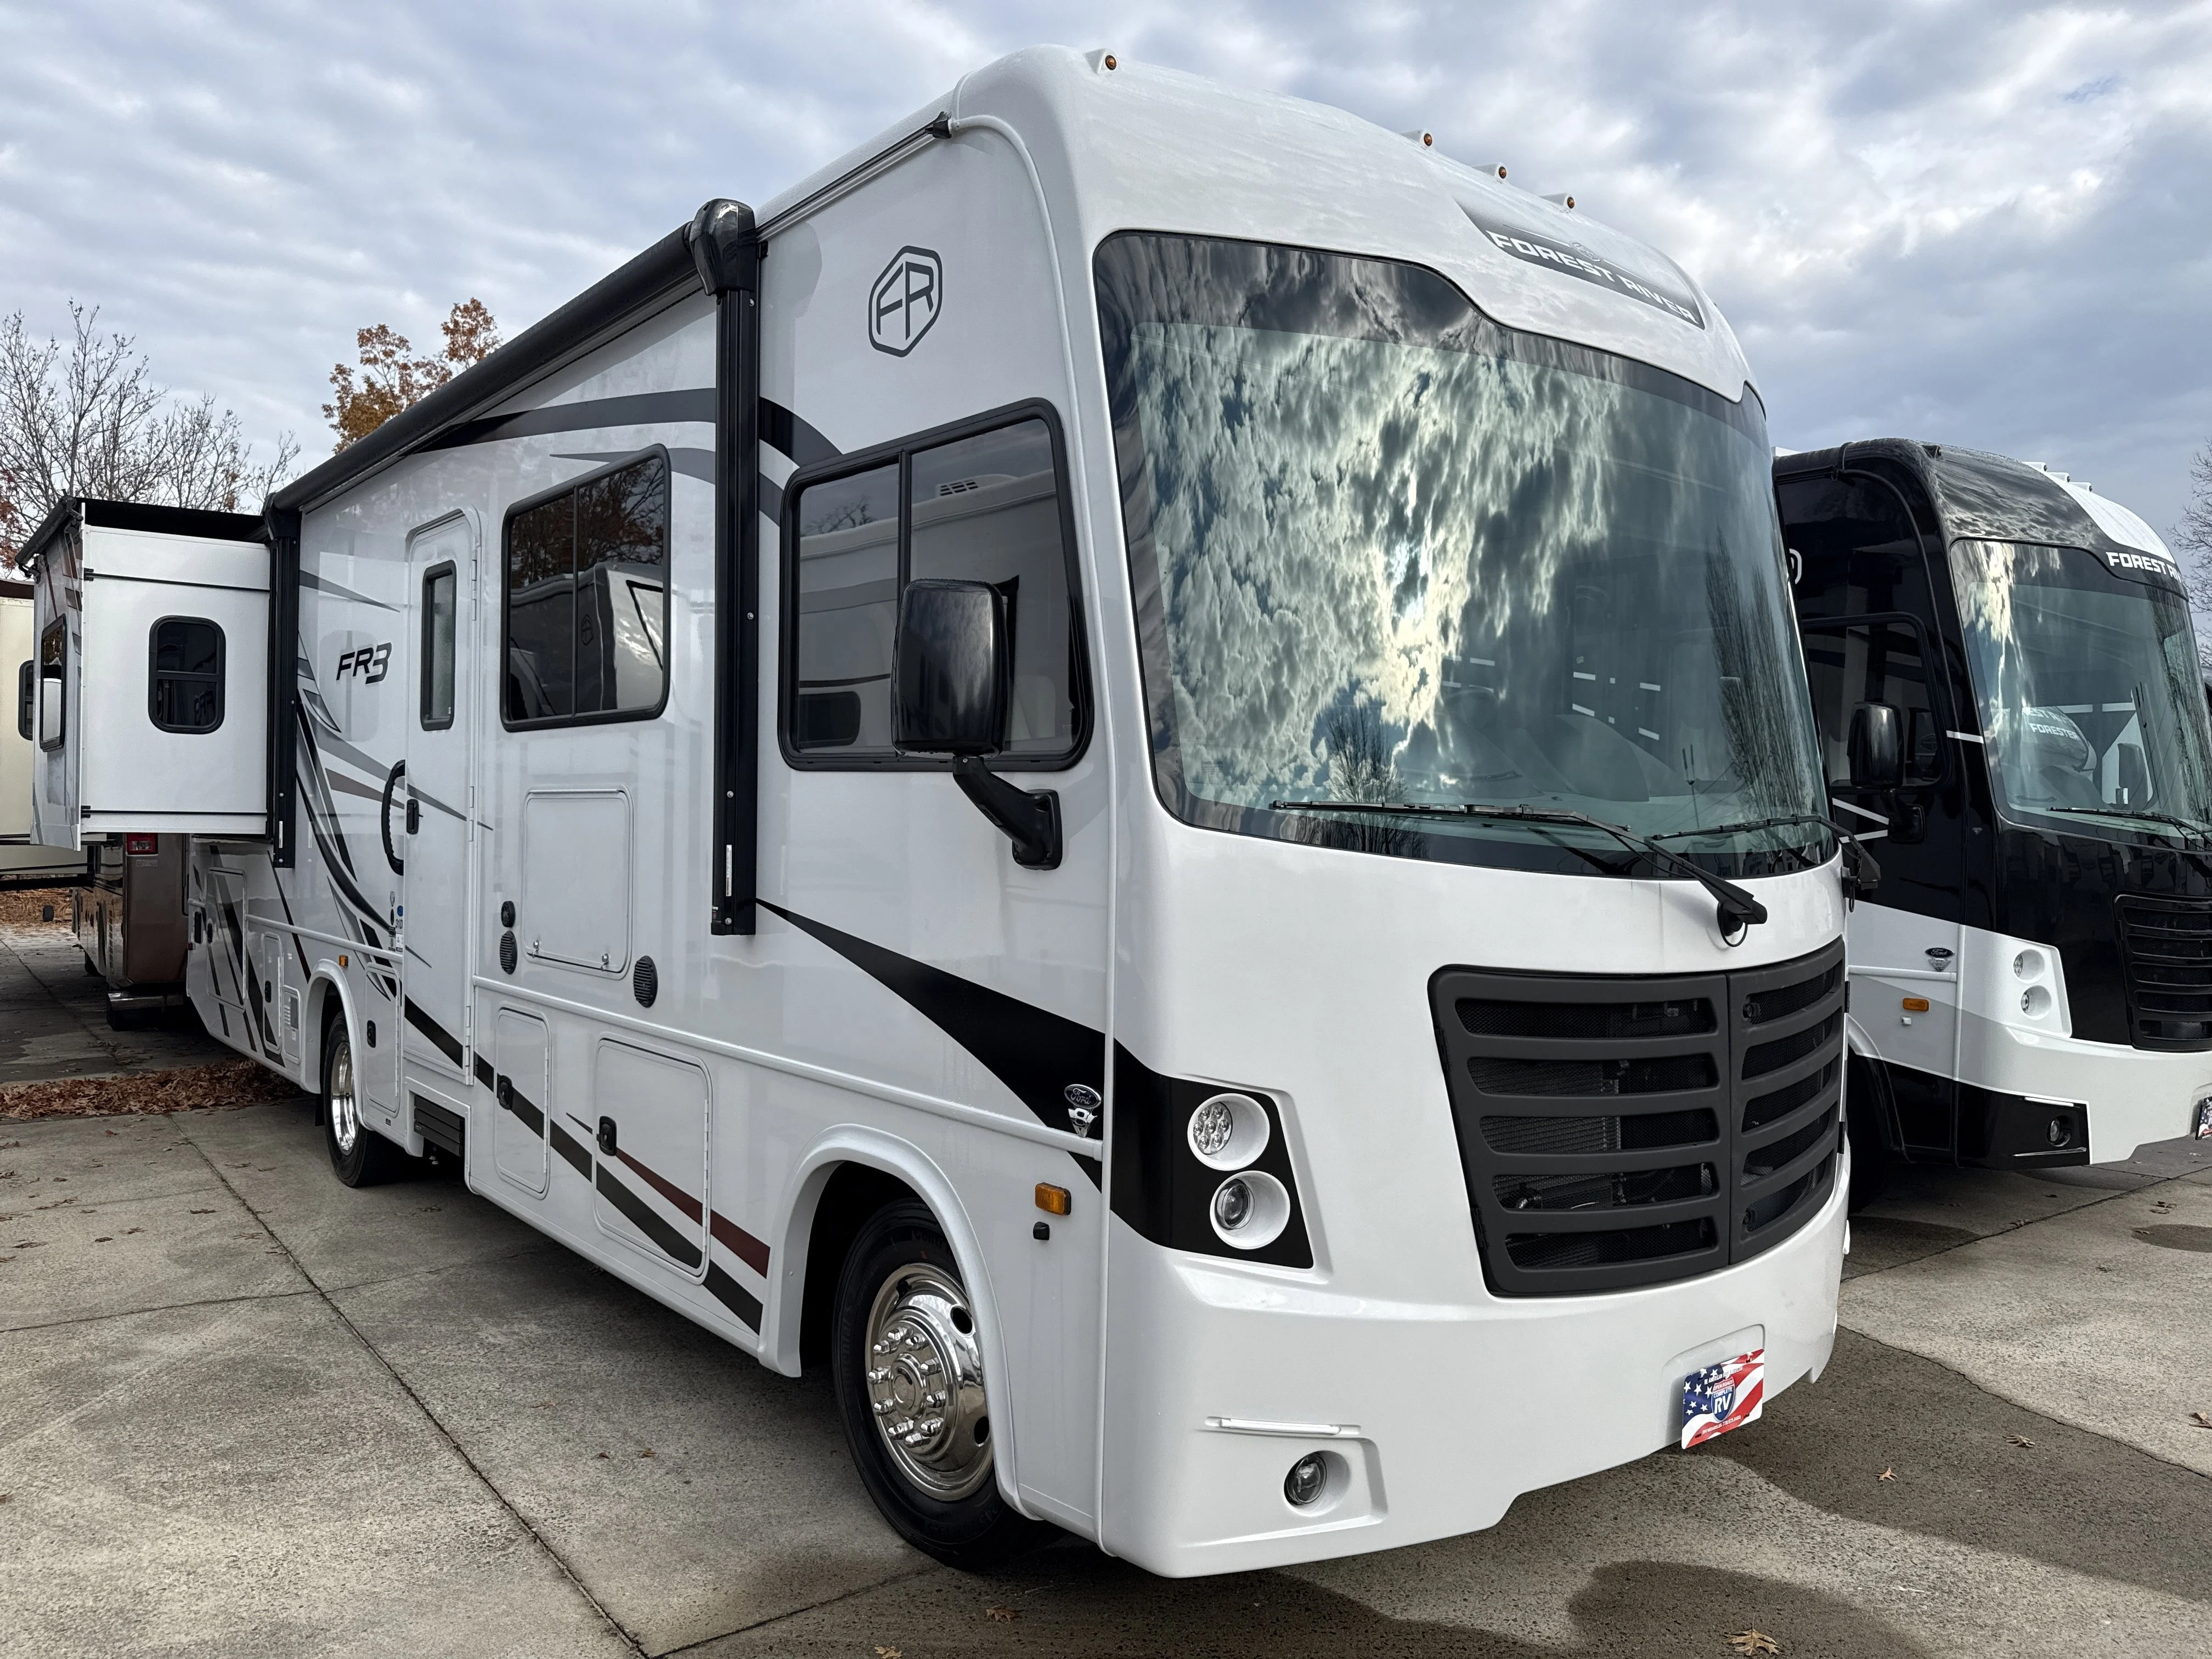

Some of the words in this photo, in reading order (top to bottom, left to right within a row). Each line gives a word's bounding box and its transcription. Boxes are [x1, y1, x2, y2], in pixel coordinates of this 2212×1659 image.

[1486, 230, 1616, 282] FOREST
[1615, 275, 1699, 323] RIVER
[2105, 551, 2167, 575] FOREST
[336, 642, 392, 685] FR3
[2028, 723, 2080, 741] FORESTER
[1070, 1087, 1092, 1105] Ford
[1713, 1386, 1733, 1398] COMPLETE
[1714, 1393, 1731, 1414] RV
